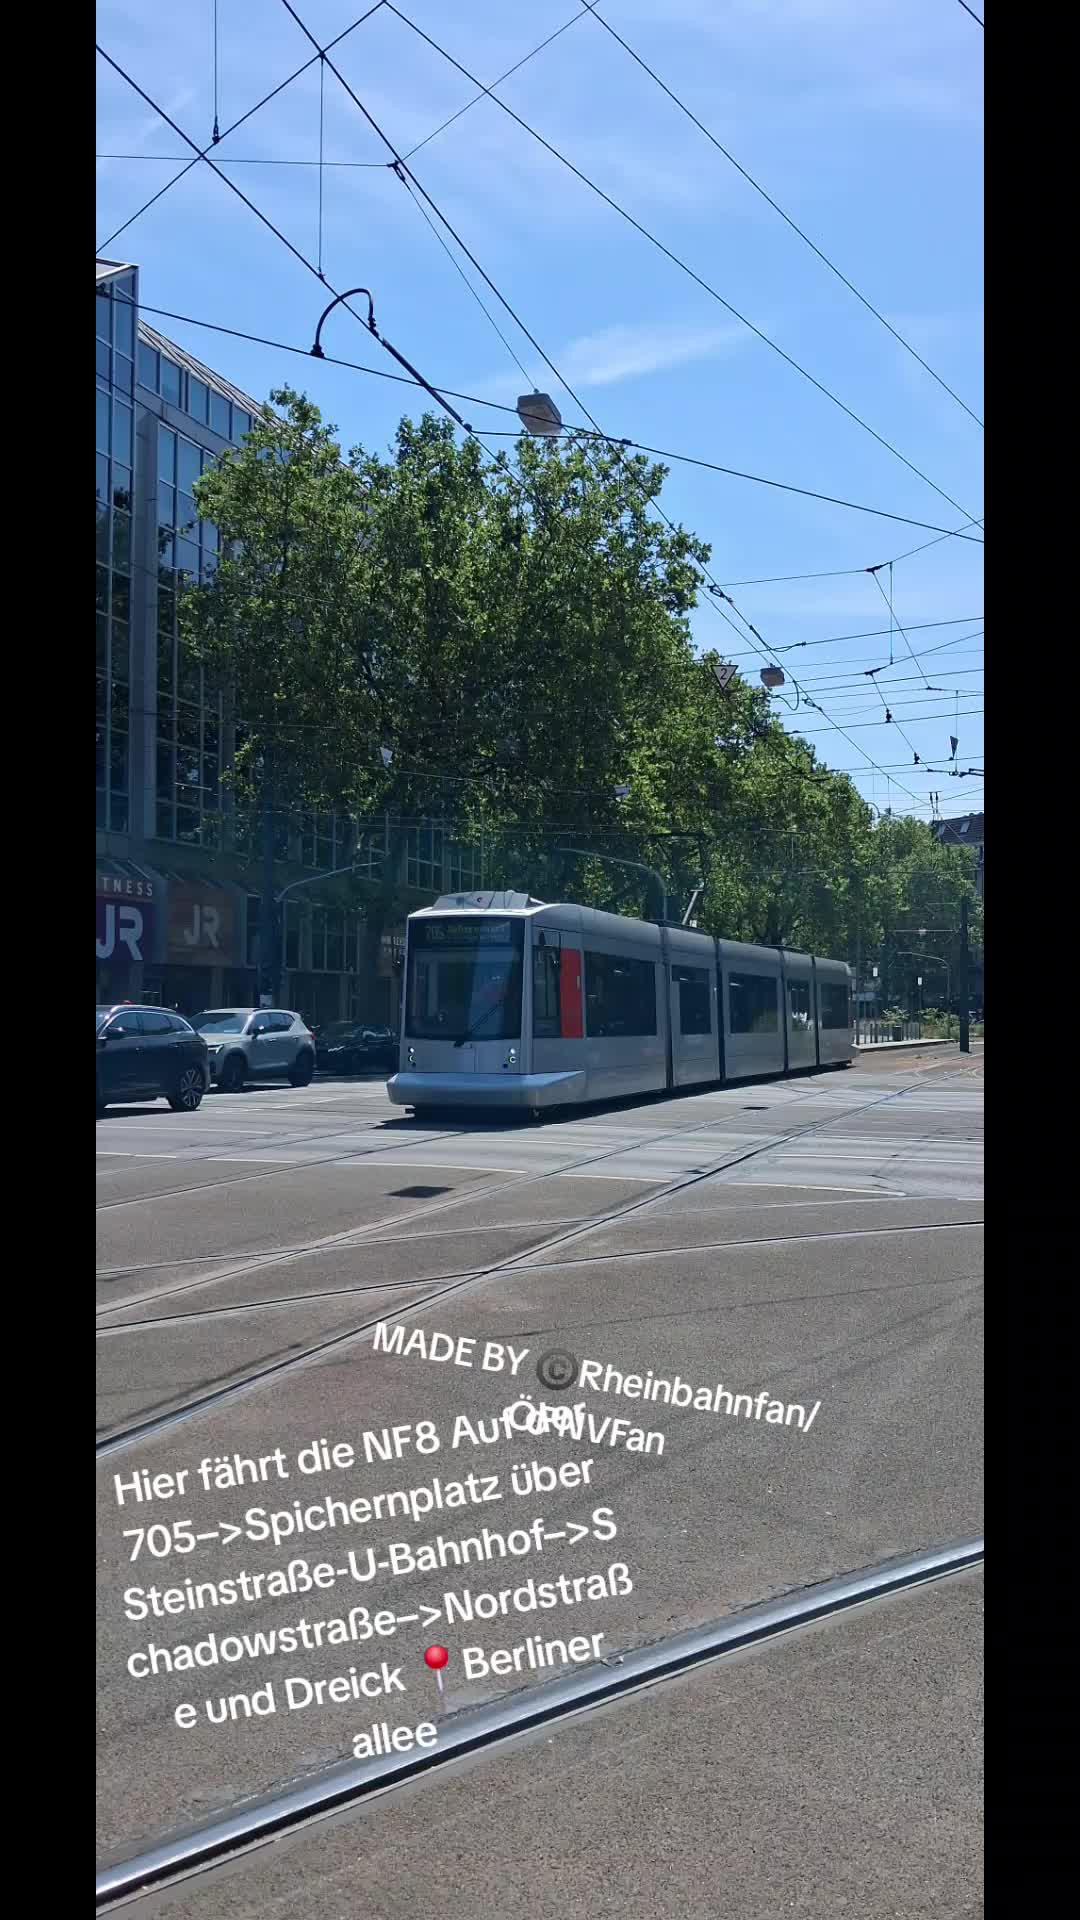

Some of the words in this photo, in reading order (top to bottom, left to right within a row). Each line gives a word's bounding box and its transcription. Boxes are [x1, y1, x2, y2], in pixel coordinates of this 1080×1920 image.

[720, 667, 728, 680] 2
[96, 904, 144, 961] JR
[183, 903, 220, 948] JR
